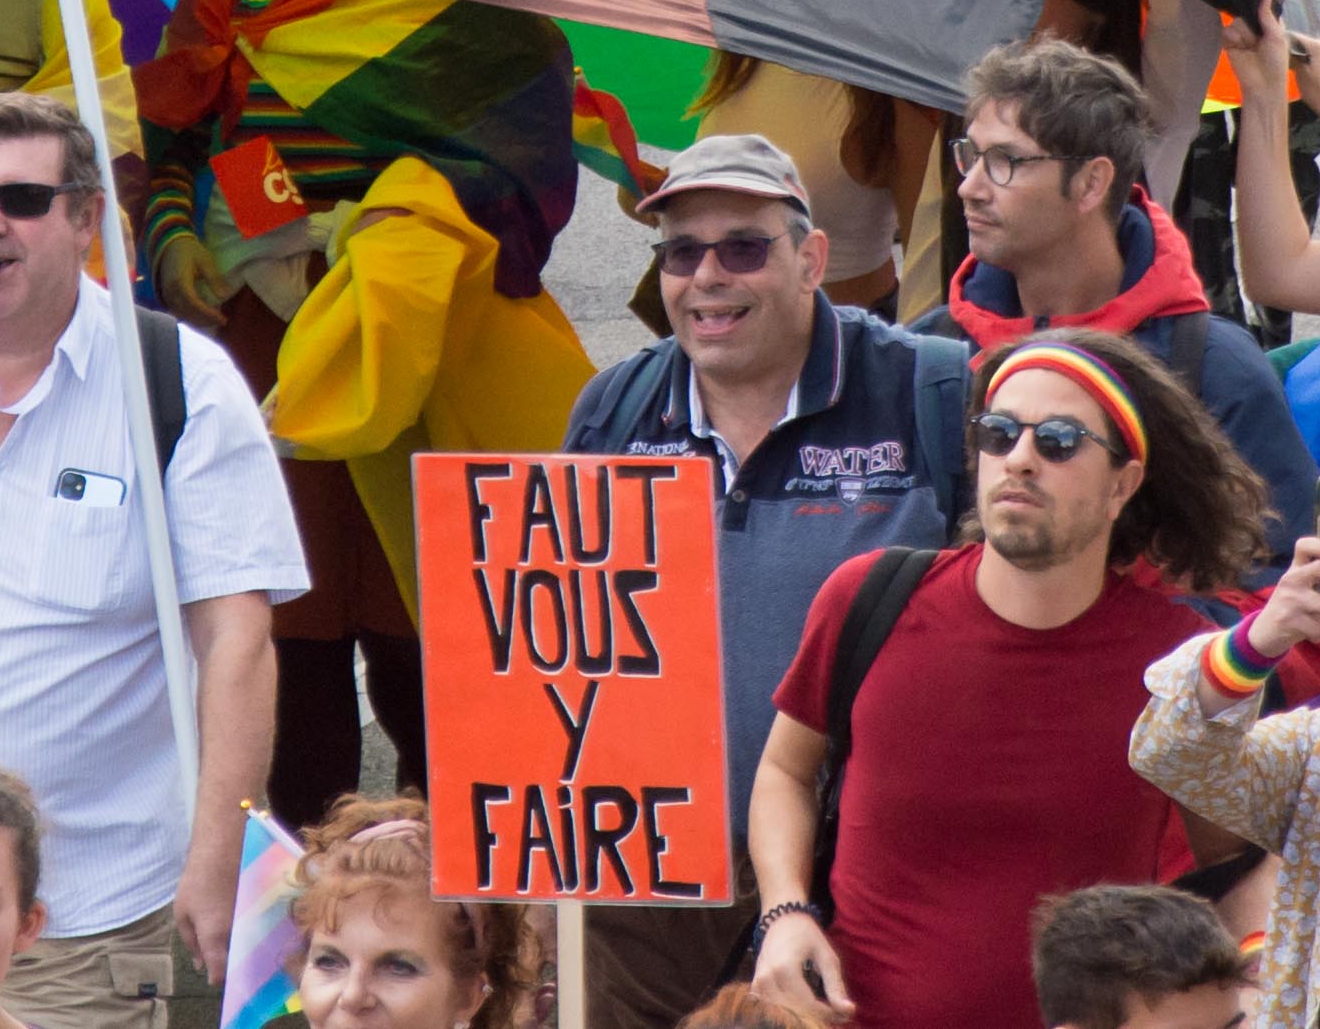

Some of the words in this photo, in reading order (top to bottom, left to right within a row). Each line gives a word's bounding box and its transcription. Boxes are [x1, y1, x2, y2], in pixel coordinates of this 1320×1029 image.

[798, 441, 906, 477] WATER
[465, 462, 679, 569] FAUT
[472, 567, 662, 678] VOUS
[543, 679, 600, 785] Y
